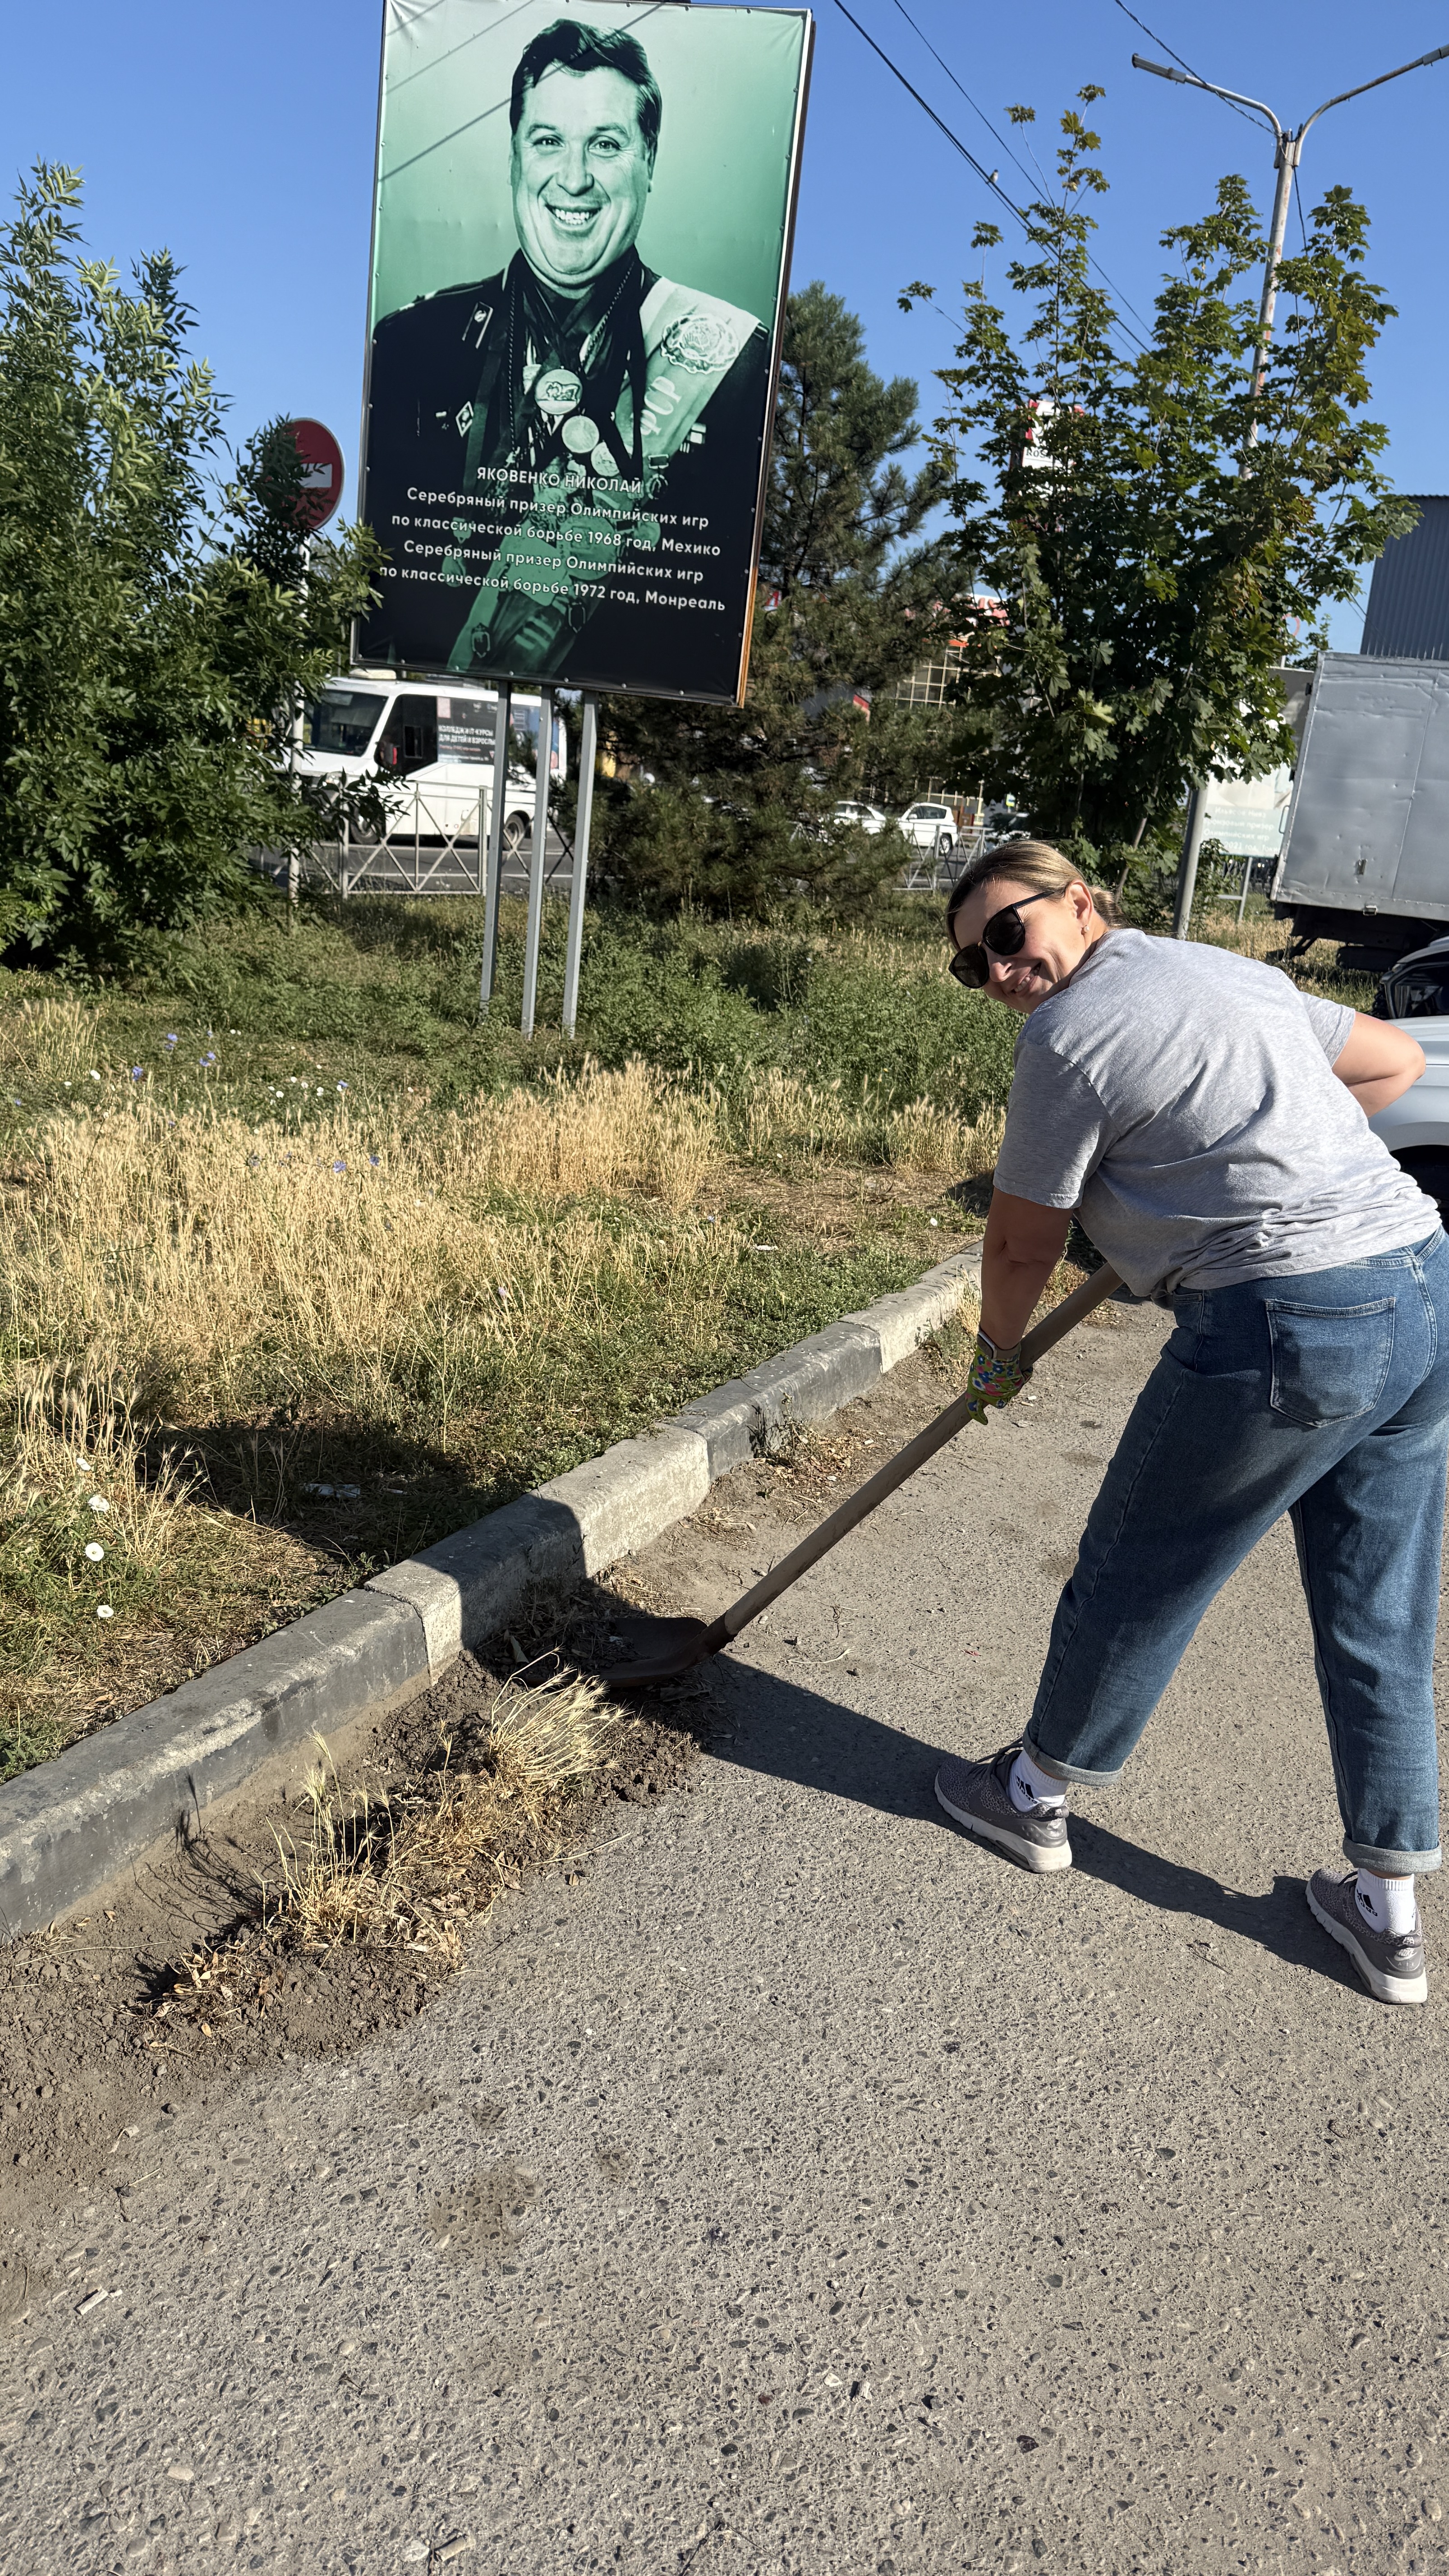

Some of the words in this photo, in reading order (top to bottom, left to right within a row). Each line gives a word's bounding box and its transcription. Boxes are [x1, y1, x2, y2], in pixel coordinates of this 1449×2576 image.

[477, 467, 560, 486] ЯКОВЕНКО
[565, 475, 641, 493] НИКОЛАЙ
[407, 487, 505, 508] Серебряный
[510, 500, 566, 516] призер
[571, 503, 677, 524] Олимпийских
[682, 516, 708, 530] игр
[392, 515, 409, 526] по
[414, 517, 521, 536] классической
[527, 526, 582, 542] борьбе
[588, 531, 621, 546] 1968
[626, 538, 656, 552] год,
[662, 538, 720, 556] Мехико
[404, 540, 501, 561] Серебряный
[506, 553, 561, 570] призер
[566, 556, 672, 578] Олимпийских
[677, 570, 703, 584] игр
[380, 567, 397, 577] по
[402, 569, 508, 589] классической
[514, 578, 568, 594] борьбе
[574, 584, 605, 598] 1972
[610, 590, 639, 604] год,
[645, 590, 725, 611] Монреаль
